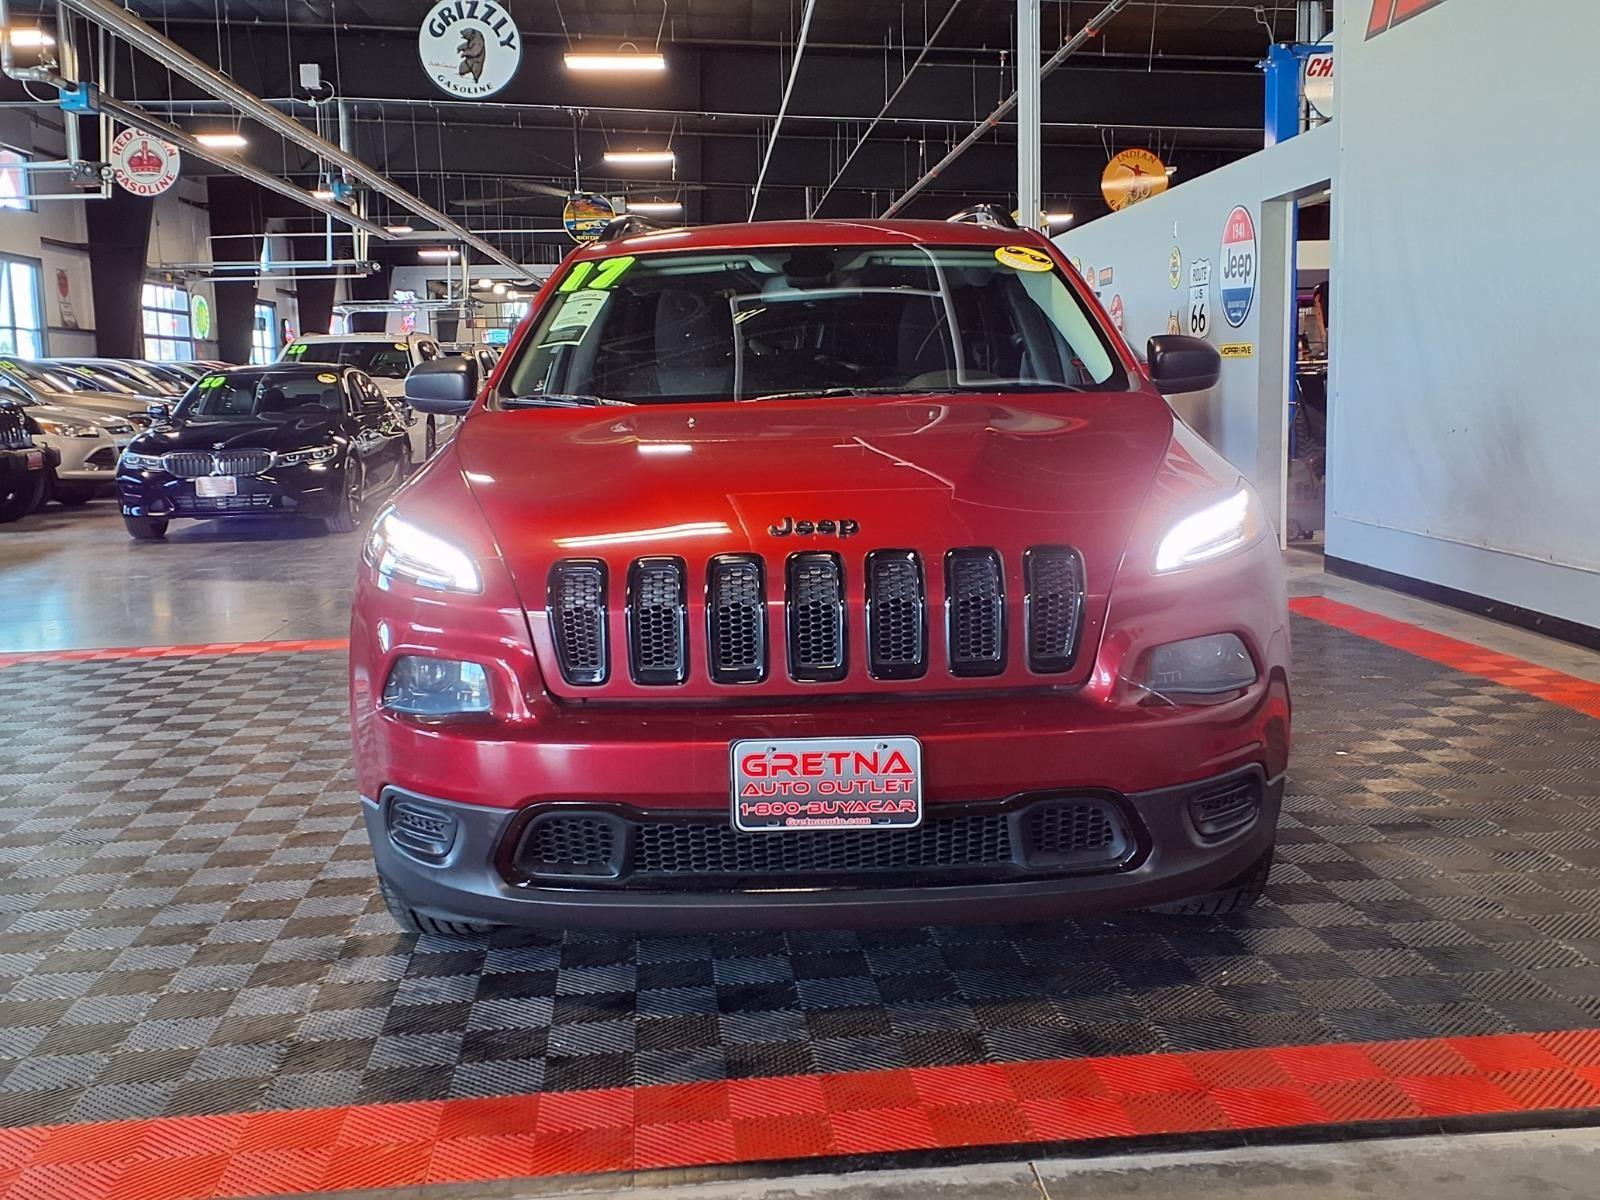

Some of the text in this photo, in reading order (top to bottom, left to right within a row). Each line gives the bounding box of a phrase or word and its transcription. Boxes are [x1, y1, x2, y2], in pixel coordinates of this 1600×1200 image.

[428, 0, 517, 51] GRIZZLY
[437, 74, 494, 94] GASOLINE
[112, 131, 133, 156] RED
[1117, 150, 1157, 164] INDIAN
[113, 168, 176, 194] GASOLINE
[1232, 221, 1245, 240] 1941
[559, 256, 636, 292] 17
[1192, 266, 1207, 282] ROUTE
[1223, 248, 1252, 284] Jeep
[1194, 288, 1203, 300] US
[1190, 303, 1206, 334] 66
[287, 344, 308, 355] 20
[199, 375, 227, 390] 20
[766, 516, 861, 539] Jeep
[740, 750, 915, 779] GRETNA
[740, 778, 917, 797] AUTO OUTLET
[739, 799, 917, 816] 1-800-BUYACAR
